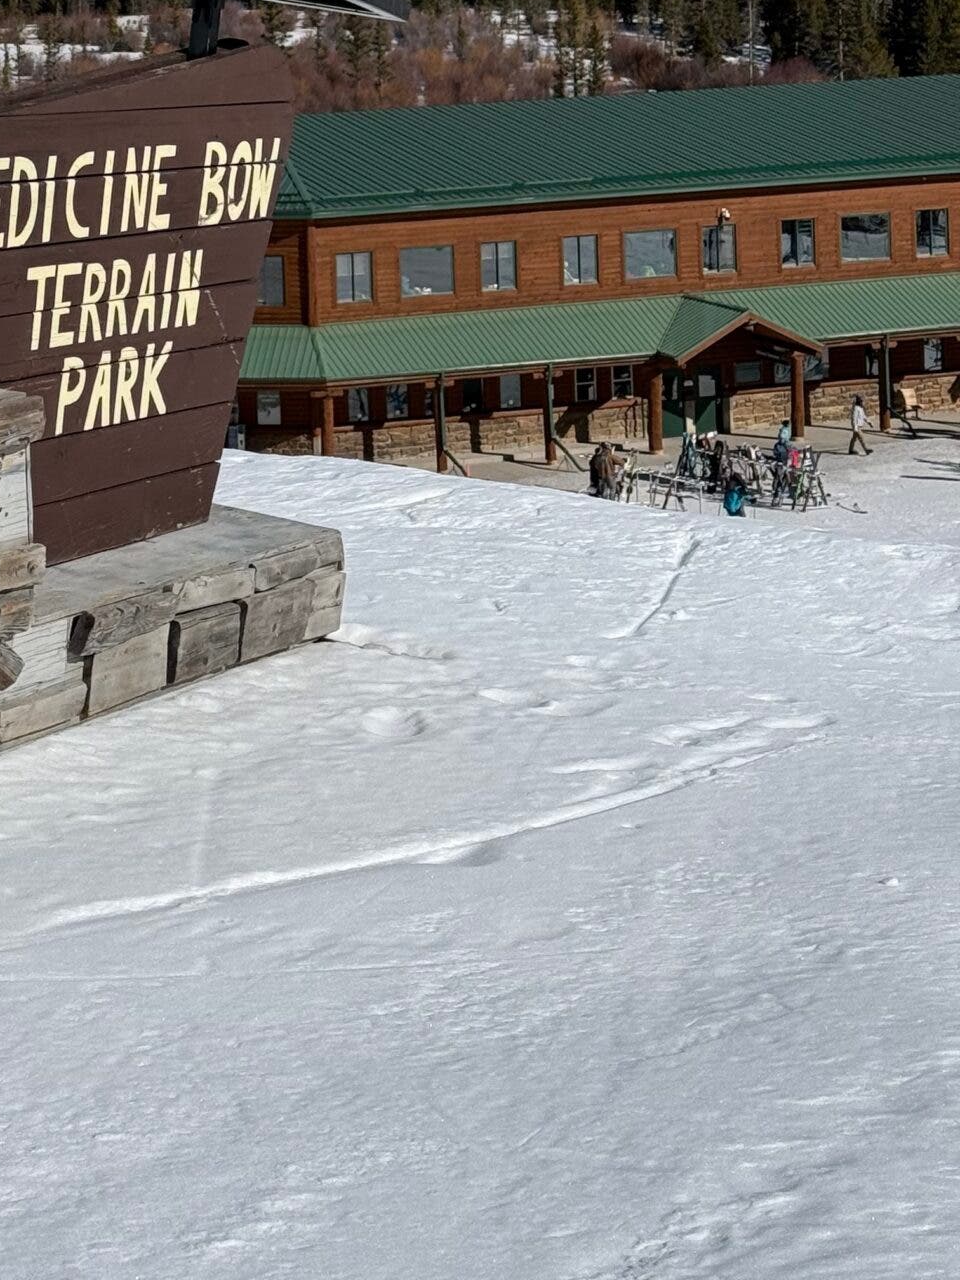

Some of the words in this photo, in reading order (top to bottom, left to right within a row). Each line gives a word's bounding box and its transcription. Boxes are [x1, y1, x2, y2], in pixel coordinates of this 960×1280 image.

[198, 137, 281, 226] BOW
[27, 249, 204, 351] TERRAIN
[55, 341, 174, 436] PARK
